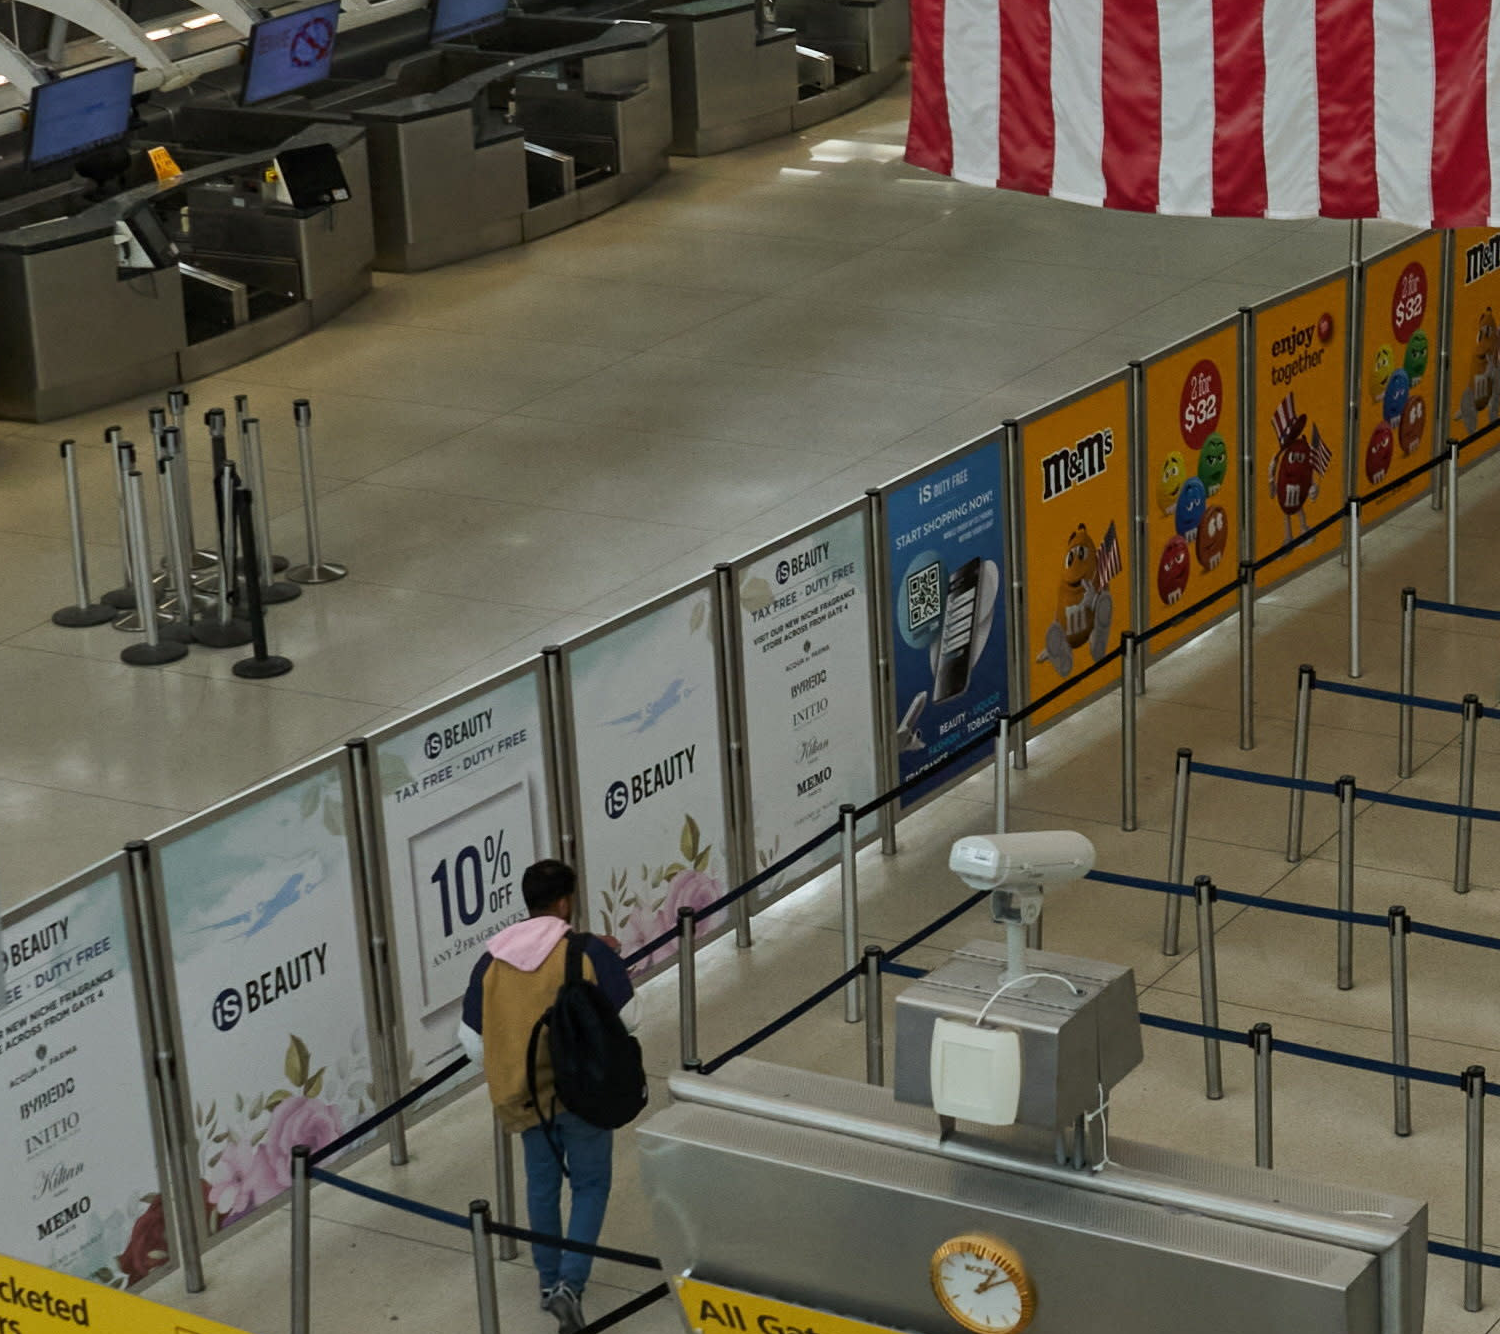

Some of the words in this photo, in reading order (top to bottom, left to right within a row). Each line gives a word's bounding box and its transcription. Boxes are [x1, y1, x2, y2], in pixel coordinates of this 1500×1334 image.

[1395, 293, 1423, 328] $32
[1271, 324, 1317, 357] enjoy
[1190, 375, 1198, 401] 2
[1198, 372, 1213, 398] for
[1271, 347, 1325, 386] together
[1184, 394, 1218, 434] $32
[895, 525, 923, 551] START
[923, 502, 968, 537] SHOPPING
[790, 541, 831, 577] BEAUTY
[772, 590, 798, 614] FREE
[804, 572, 830, 597] DUTY
[831, 561, 856, 584] FREE
[443, 707, 494, 750] BEAUTY
[394, 779, 420, 804] TAX
[421, 765, 454, 791] FREE
[462, 744, 495, 772] DUTY
[497, 728, 528, 753] FREE
[605, 780, 628, 819] iS
[630, 743, 697, 805] BEAUTY
[796, 765, 833, 798] MEMO
[488, 881, 514, 914] OFF
[10, 916, 70, 968] BEAUTY
[34, 956, 74, 989] DUTY
[75, 935, 113, 967] FREE
[5, 1015, 29, 1034] NEW
[29, 1000, 58, 1020] NICHE
[58, 967, 116, 1006] FRAGRANCE
[212, 988, 242, 1032] iS
[245, 941, 328, 1015] BEAUTY
[4, 1023, 43, 1052] ACROSS
[43, 1007, 71, 1028] FROM
[71, 995, 97, 1014] GATE
[19, 1076, 76, 1121] BYREDO
[25, 1110, 81, 1155] INITIO
[35, 1194, 92, 1242] MEMO
[697, 1295, 749, 1334] All
